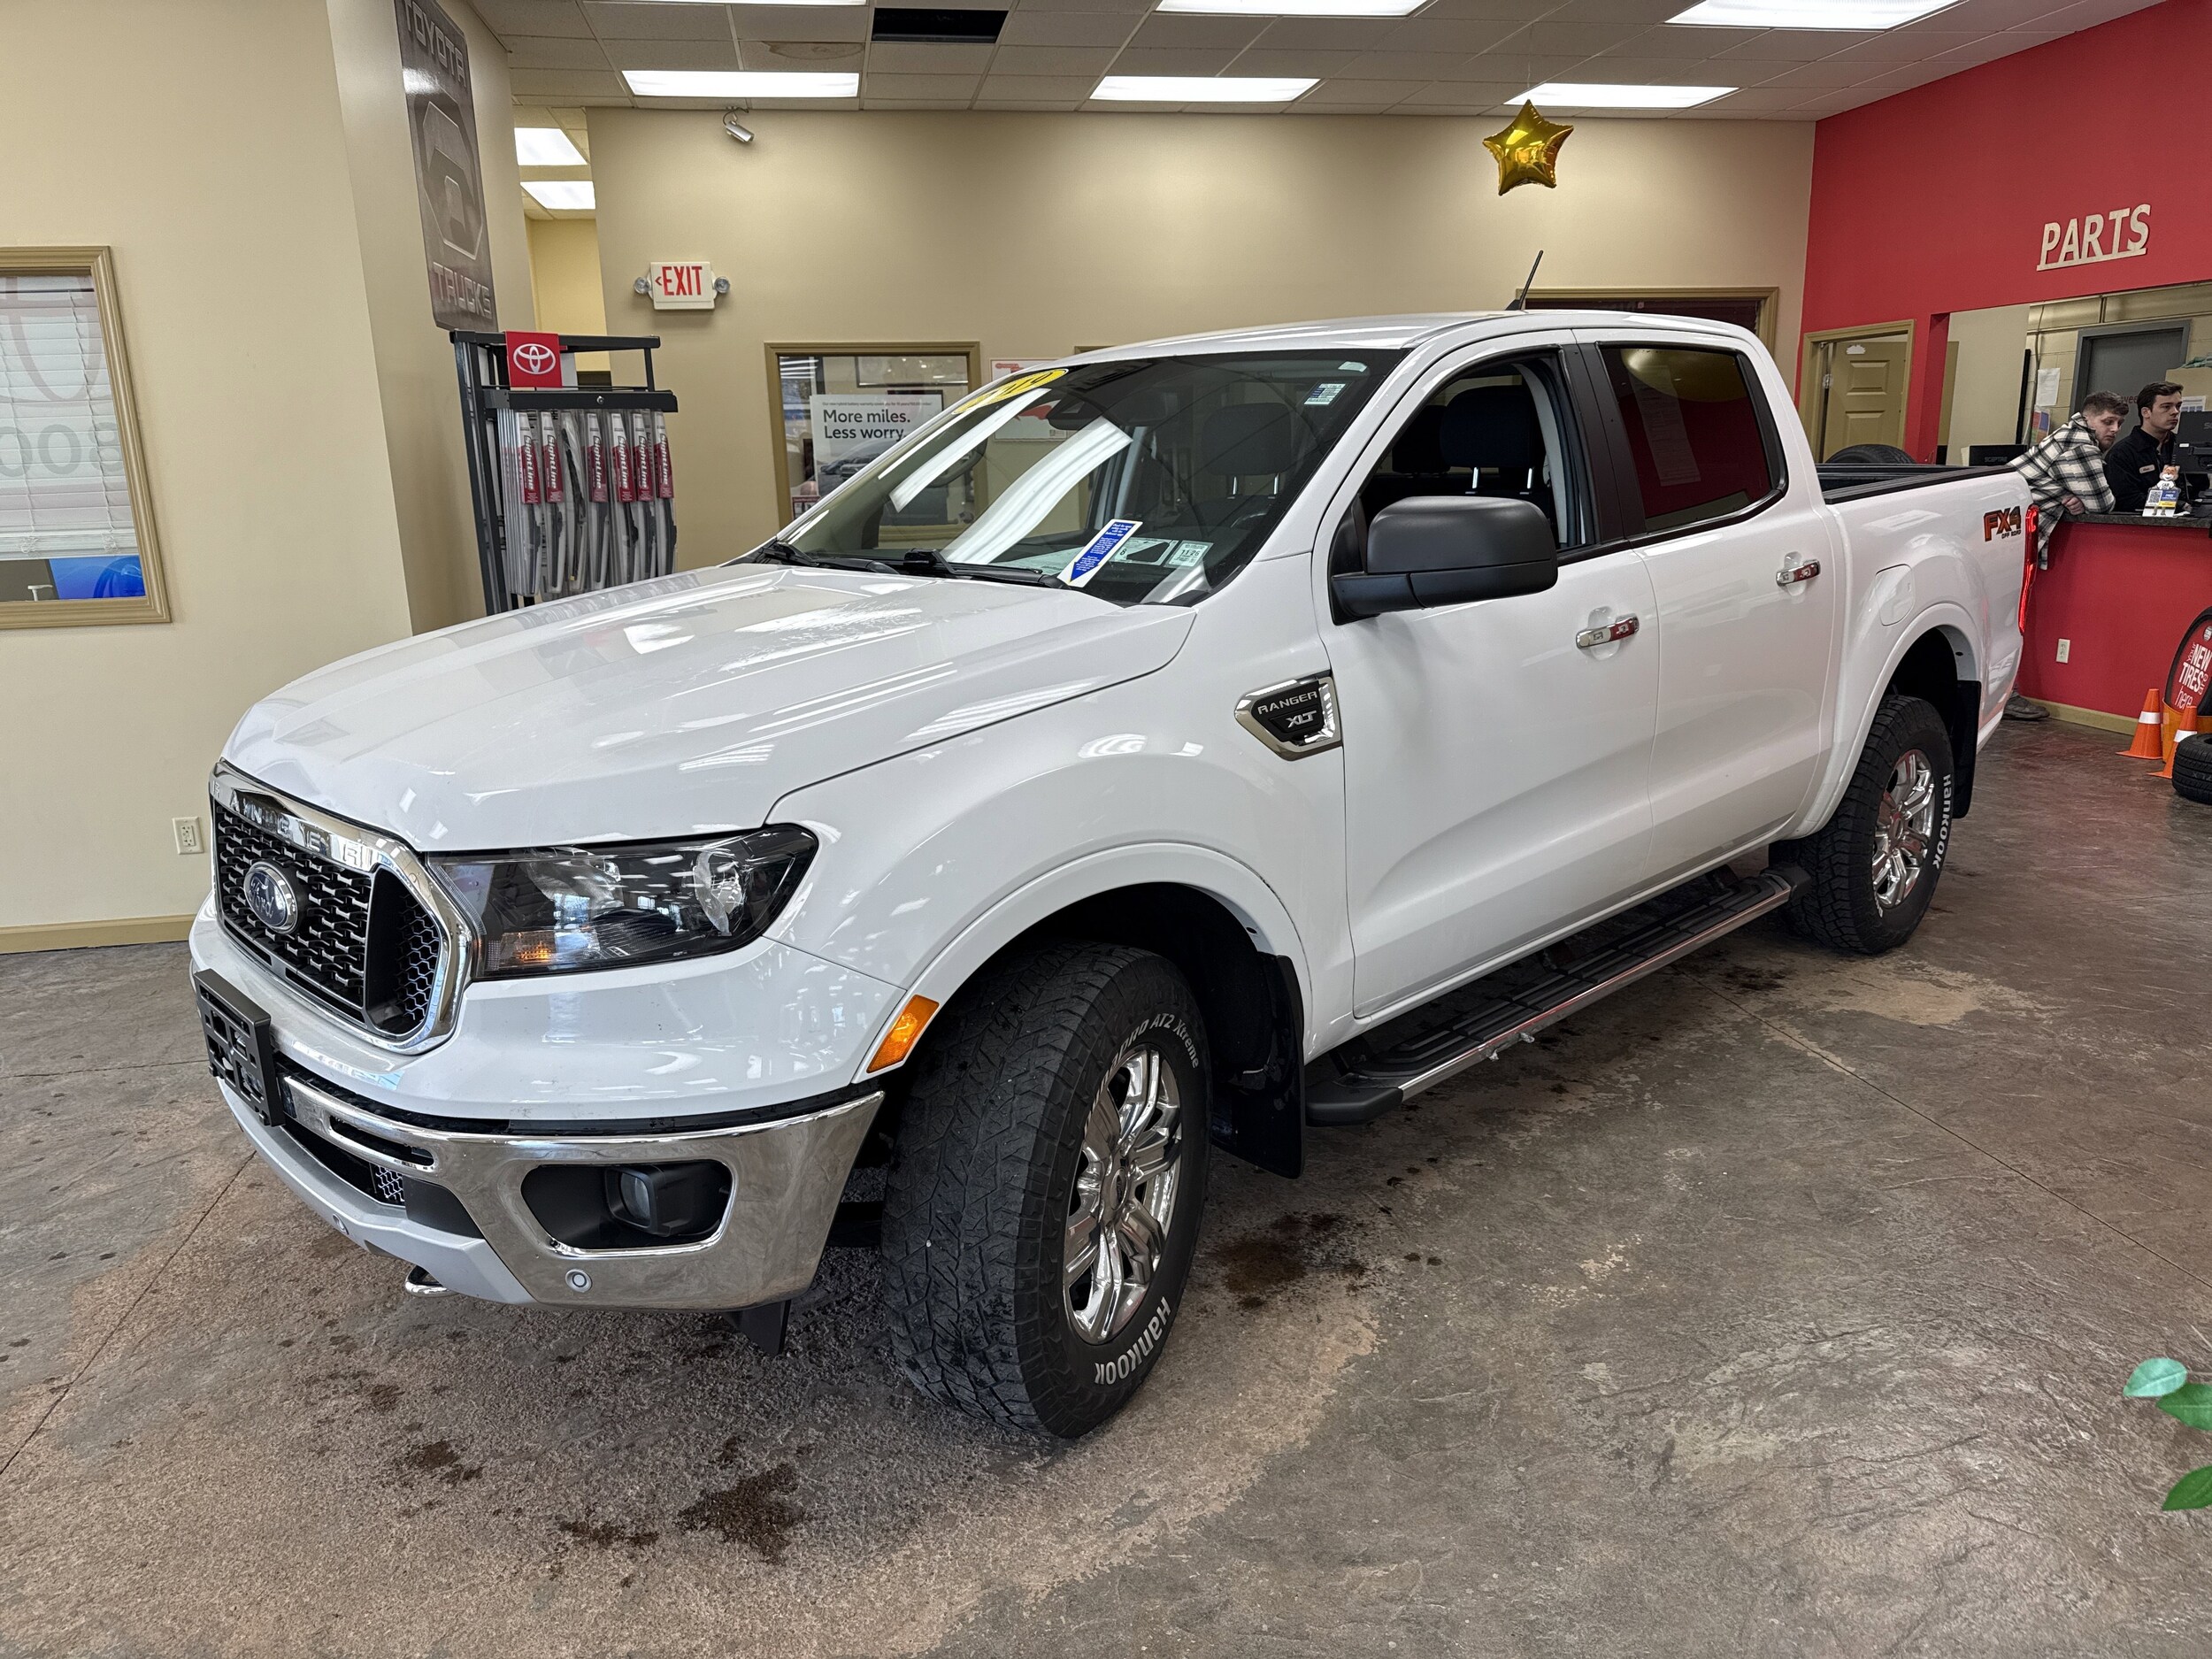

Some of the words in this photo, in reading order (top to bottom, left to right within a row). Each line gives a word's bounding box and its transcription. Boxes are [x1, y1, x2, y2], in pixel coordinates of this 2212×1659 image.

[404, 0, 467, 88] TOYOTA
[2037, 204, 2151, 270] PARTS
[433, 261, 493, 319] TRUCKS
[661, 265, 703, 296] EXIT
[823, 410, 863, 423] More
[867, 409, 910, 423] miles.
[825, 426, 856, 439] Less
[1983, 505, 2022, 541] FX4
[2190, 643, 2212, 672] NEW
[2178, 662, 2204, 693] TIRES
[1257, 691, 1317, 715] RANGER
[2174, 686, 2193, 710] here
[1286, 710, 1317, 728] XLT
[211, 780, 364, 870] RANGER
[250, 876, 276, 918] Ford
[1149, 1013, 1175, 1030] AT2
[1172, 1018, 1199, 1069] Xtreme
